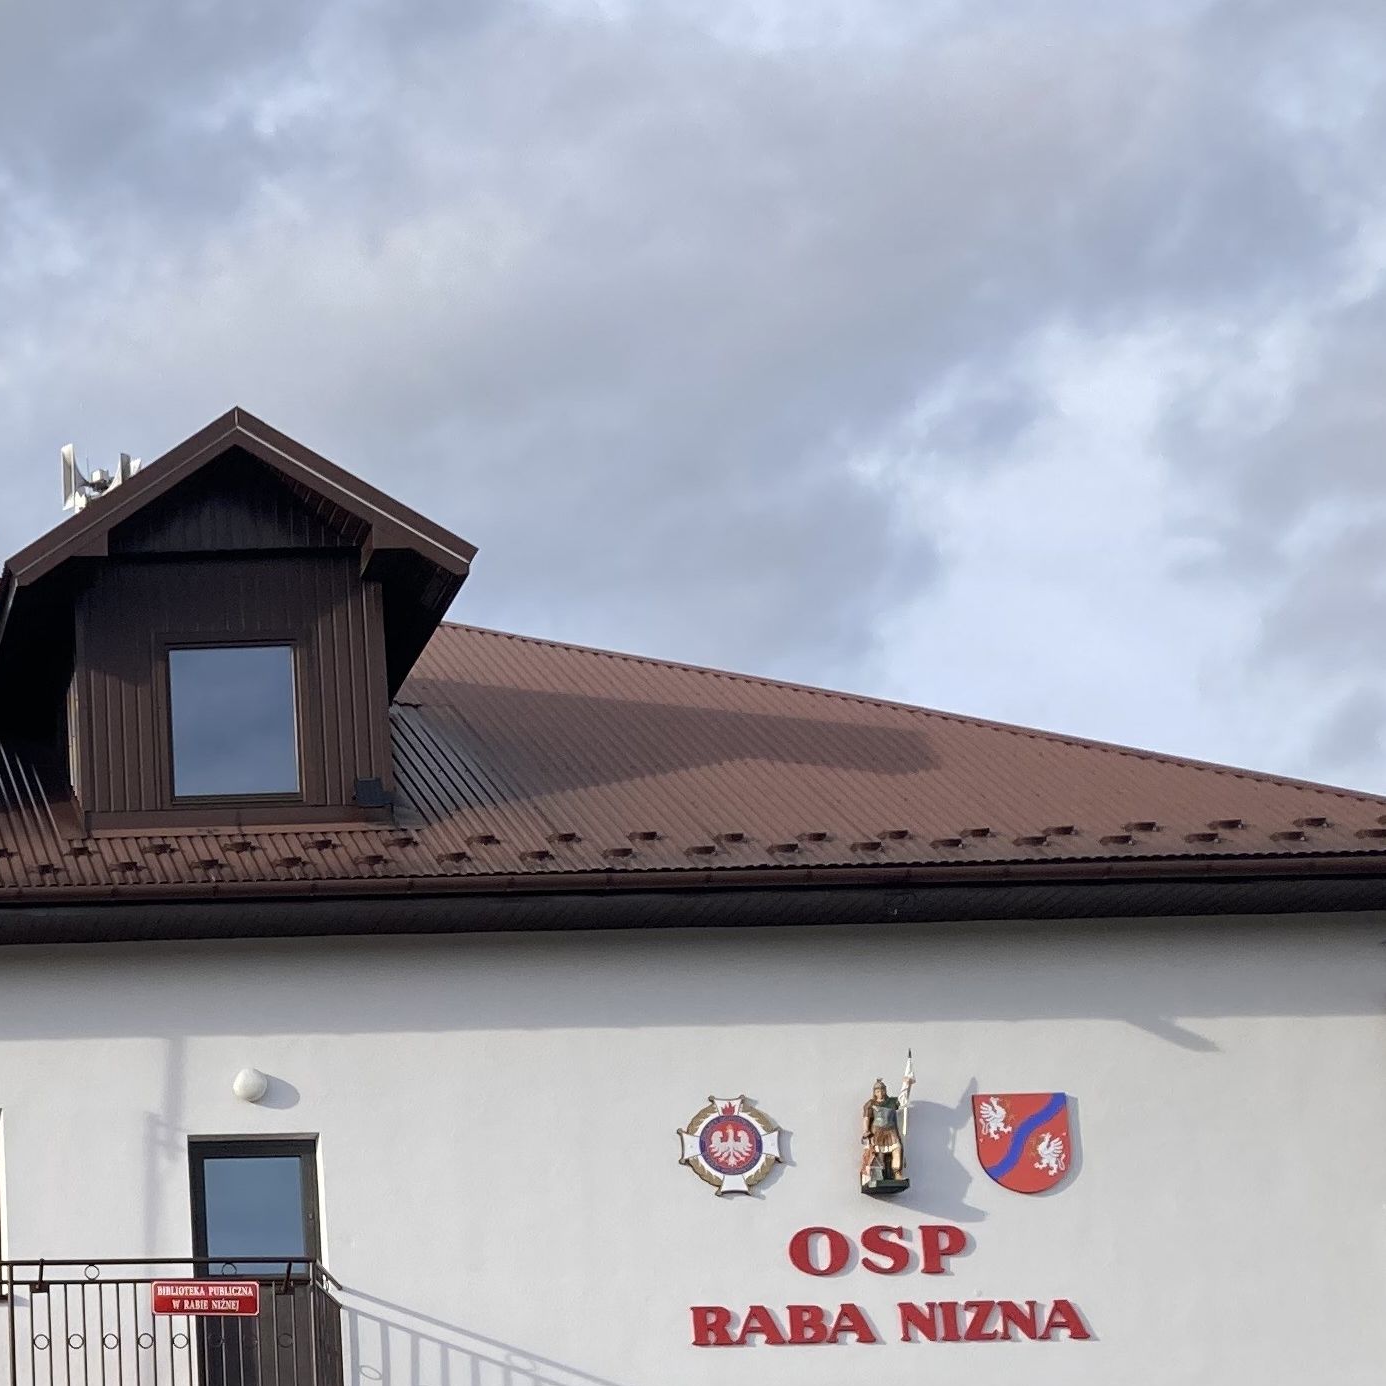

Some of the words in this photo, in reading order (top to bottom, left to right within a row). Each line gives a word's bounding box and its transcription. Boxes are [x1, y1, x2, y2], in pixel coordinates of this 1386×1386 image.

[788, 1225, 967, 1276] OSP
[157, 1286, 205, 1296] BIBLIOTEKA
[208, 1286, 254, 1296] PUBLICZNA
[172, 1299, 180, 1309] W
[183, 1299, 209, 1310] RABIE
[689, 1303, 877, 1346] RABA
